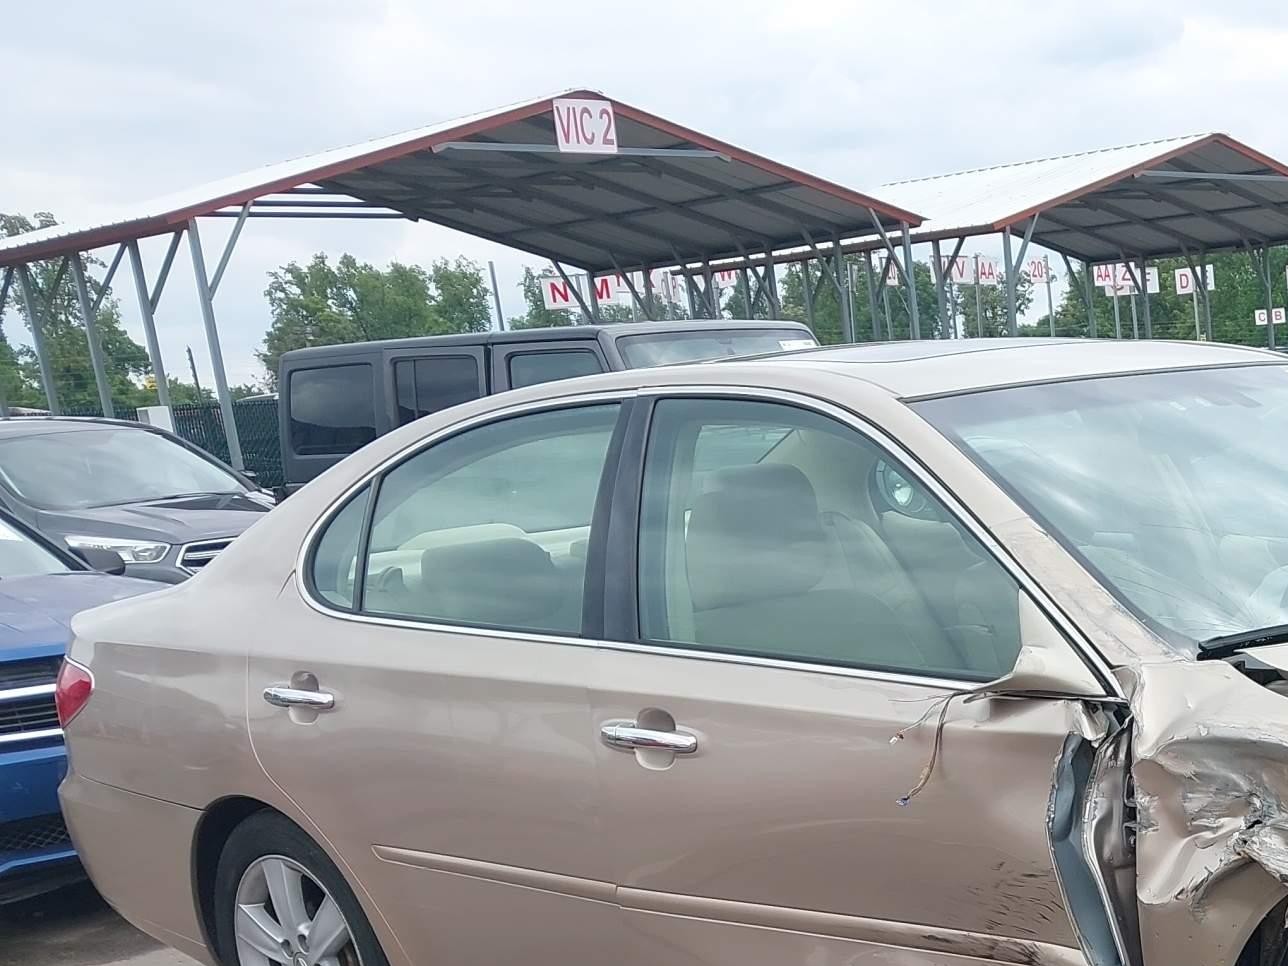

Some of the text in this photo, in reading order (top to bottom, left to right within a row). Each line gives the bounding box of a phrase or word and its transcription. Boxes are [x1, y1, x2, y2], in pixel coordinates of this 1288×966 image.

[555, 105, 615, 146] VIC 2
[980, 262, 995, 280] AA
[1096, 264, 1111, 281] AA
[1180, 273, 1189, 289] D
[550, 281, 569, 303] N
[1258, 312, 1266, 322] C
[1274, 311, 1282, 320] B
